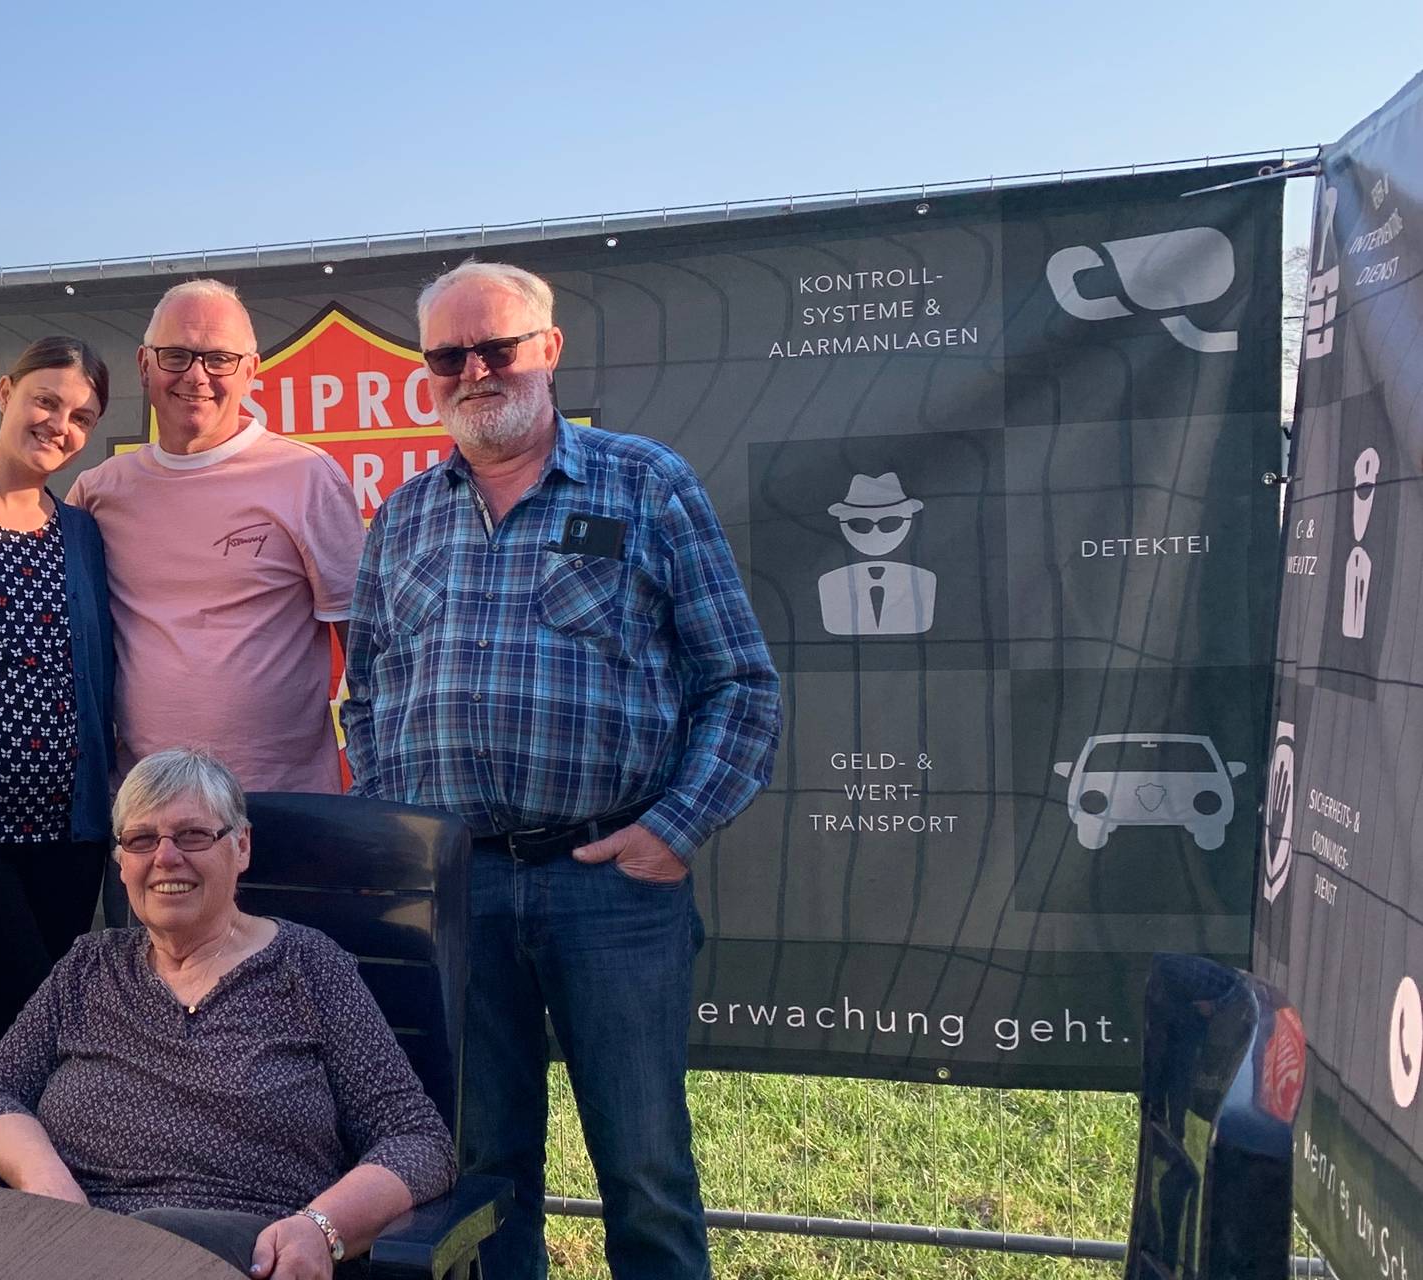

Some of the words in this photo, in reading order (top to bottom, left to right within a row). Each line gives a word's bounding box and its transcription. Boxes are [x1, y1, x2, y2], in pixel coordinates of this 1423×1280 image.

[799, 267, 944, 294] KONTROLL-
[1356, 256, 1399, 286] DIENST
[803, 299, 915, 325] SYSTEME
[925, 298, 941, 316] &
[768, 327, 978, 359] ALARMANLAGEN
[1306, 519, 1315, 539] &
[1081, 535, 1210, 558] DETEKTEI
[830, 752, 906, 770] GELD-
[917, 752, 933, 770] &
[844, 784, 920, 801] WERT-
[808, 814, 959, 833] TRANSPORT
[1308, 788, 1352, 829] SICHERHEITS-
[1353, 811, 1361, 833] &
[994, 1009, 1130, 1051] geht.
